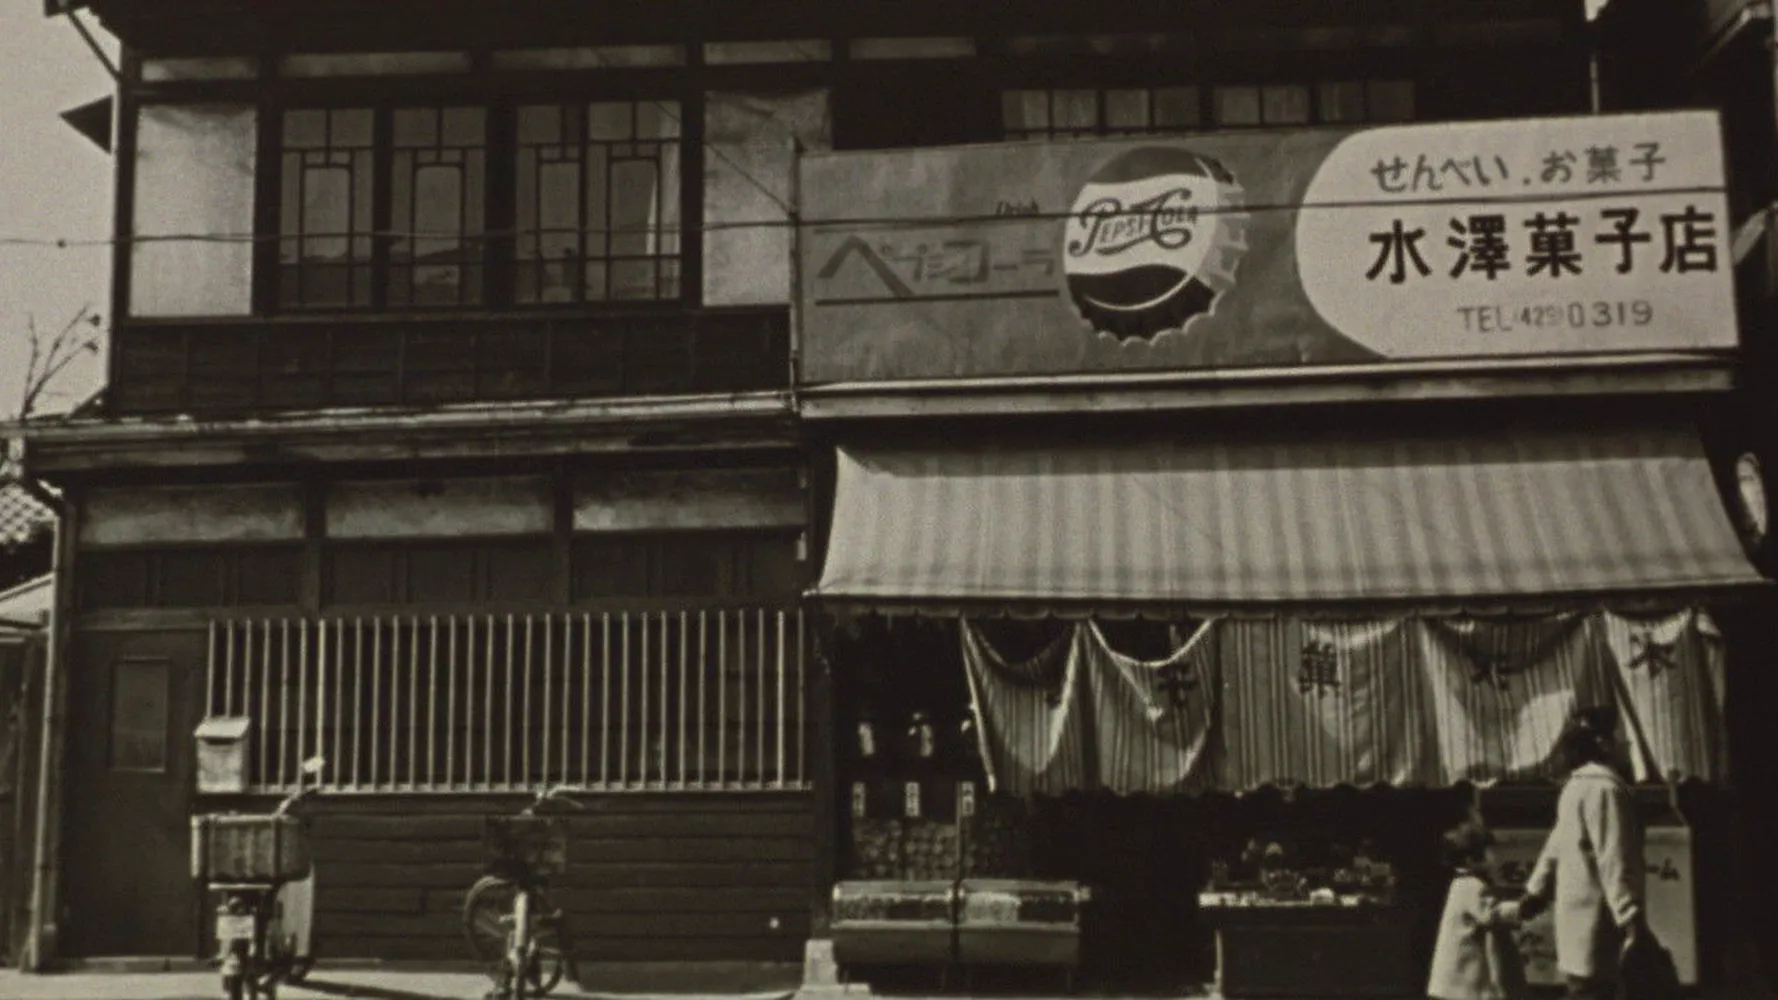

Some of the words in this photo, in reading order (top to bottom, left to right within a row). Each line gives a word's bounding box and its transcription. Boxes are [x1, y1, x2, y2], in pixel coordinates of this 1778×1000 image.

[1366, 205, 1718, 285] 水澤菓子店
